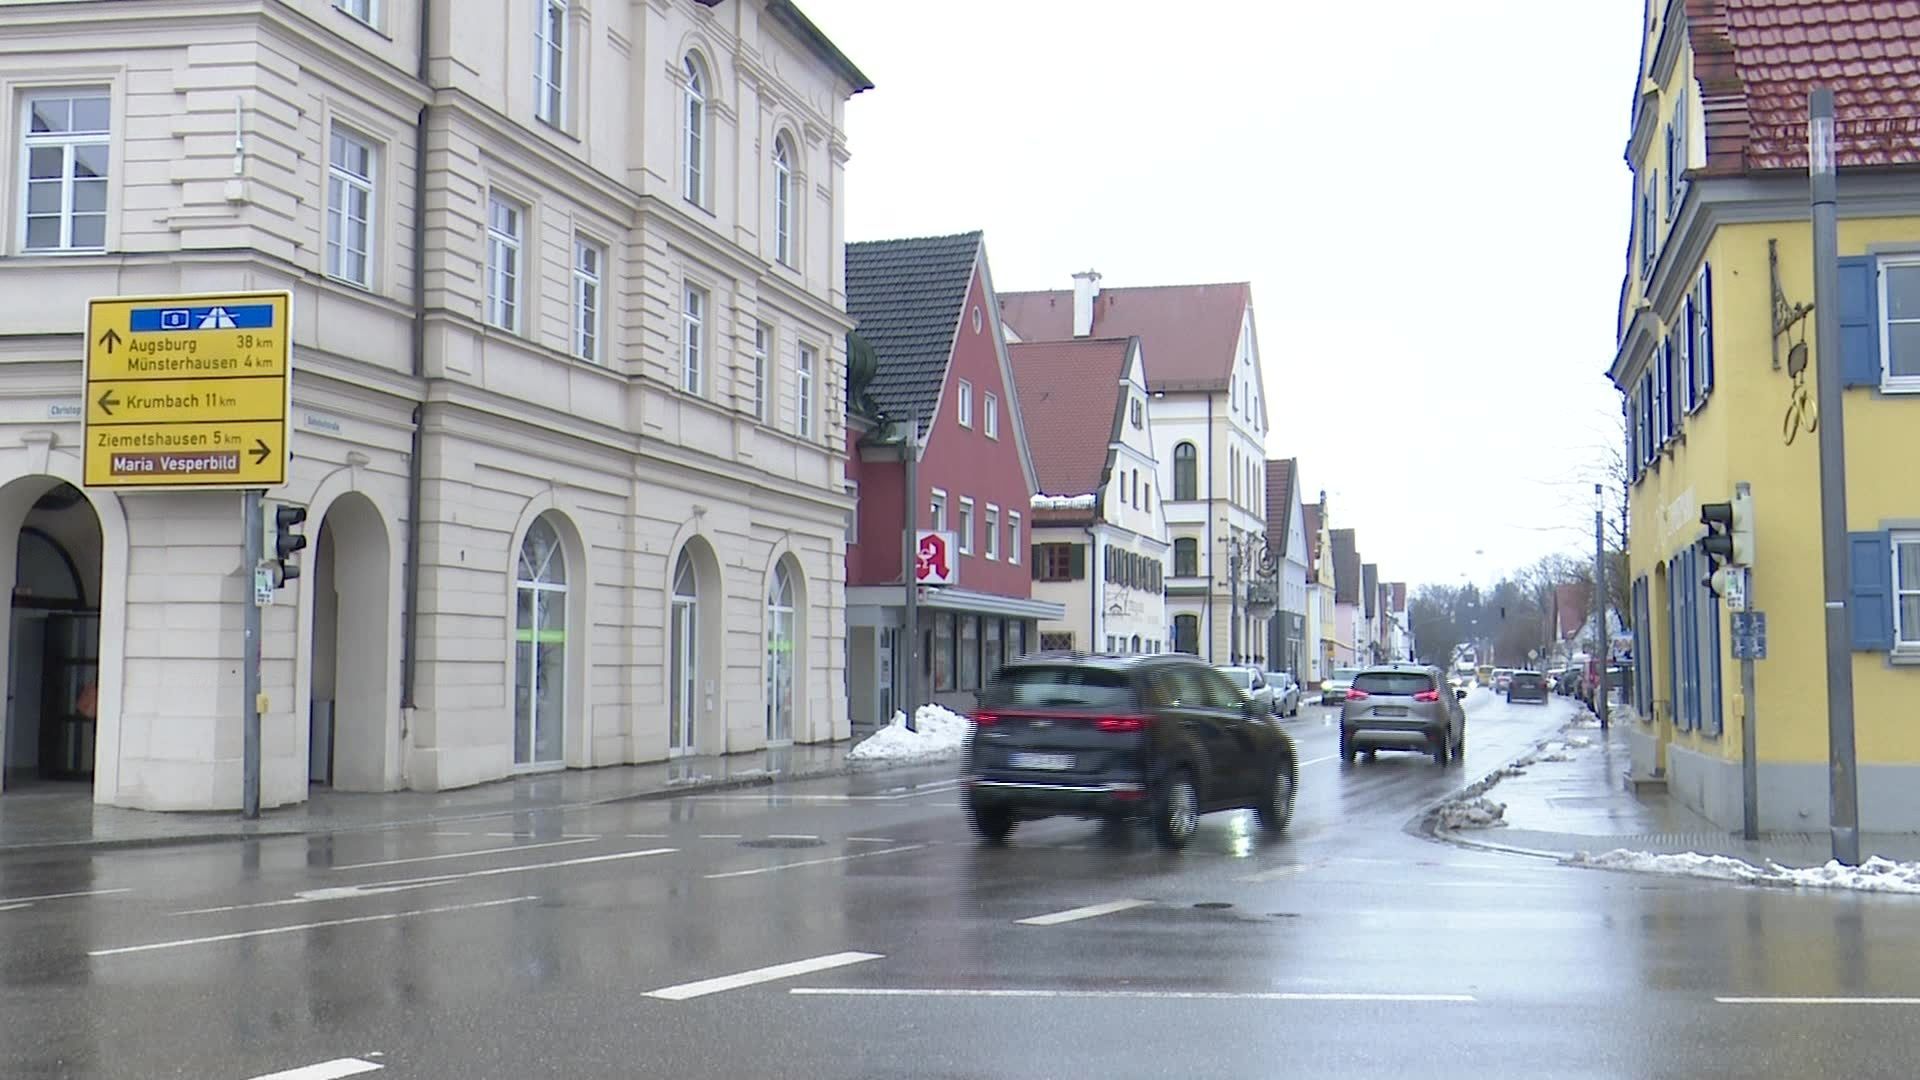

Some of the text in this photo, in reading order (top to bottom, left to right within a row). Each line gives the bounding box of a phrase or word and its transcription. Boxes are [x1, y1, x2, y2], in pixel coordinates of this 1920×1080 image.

[129, 335, 273, 355] Augsburg 38 km
[127, 354, 273, 372] Münsterhausen 4 km
[126, 393, 236, 409] Krumbach 11 km
[98, 431, 241, 447] Ziemetshausen 5 km
[113, 455, 237, 474] Maria Vesperbild
